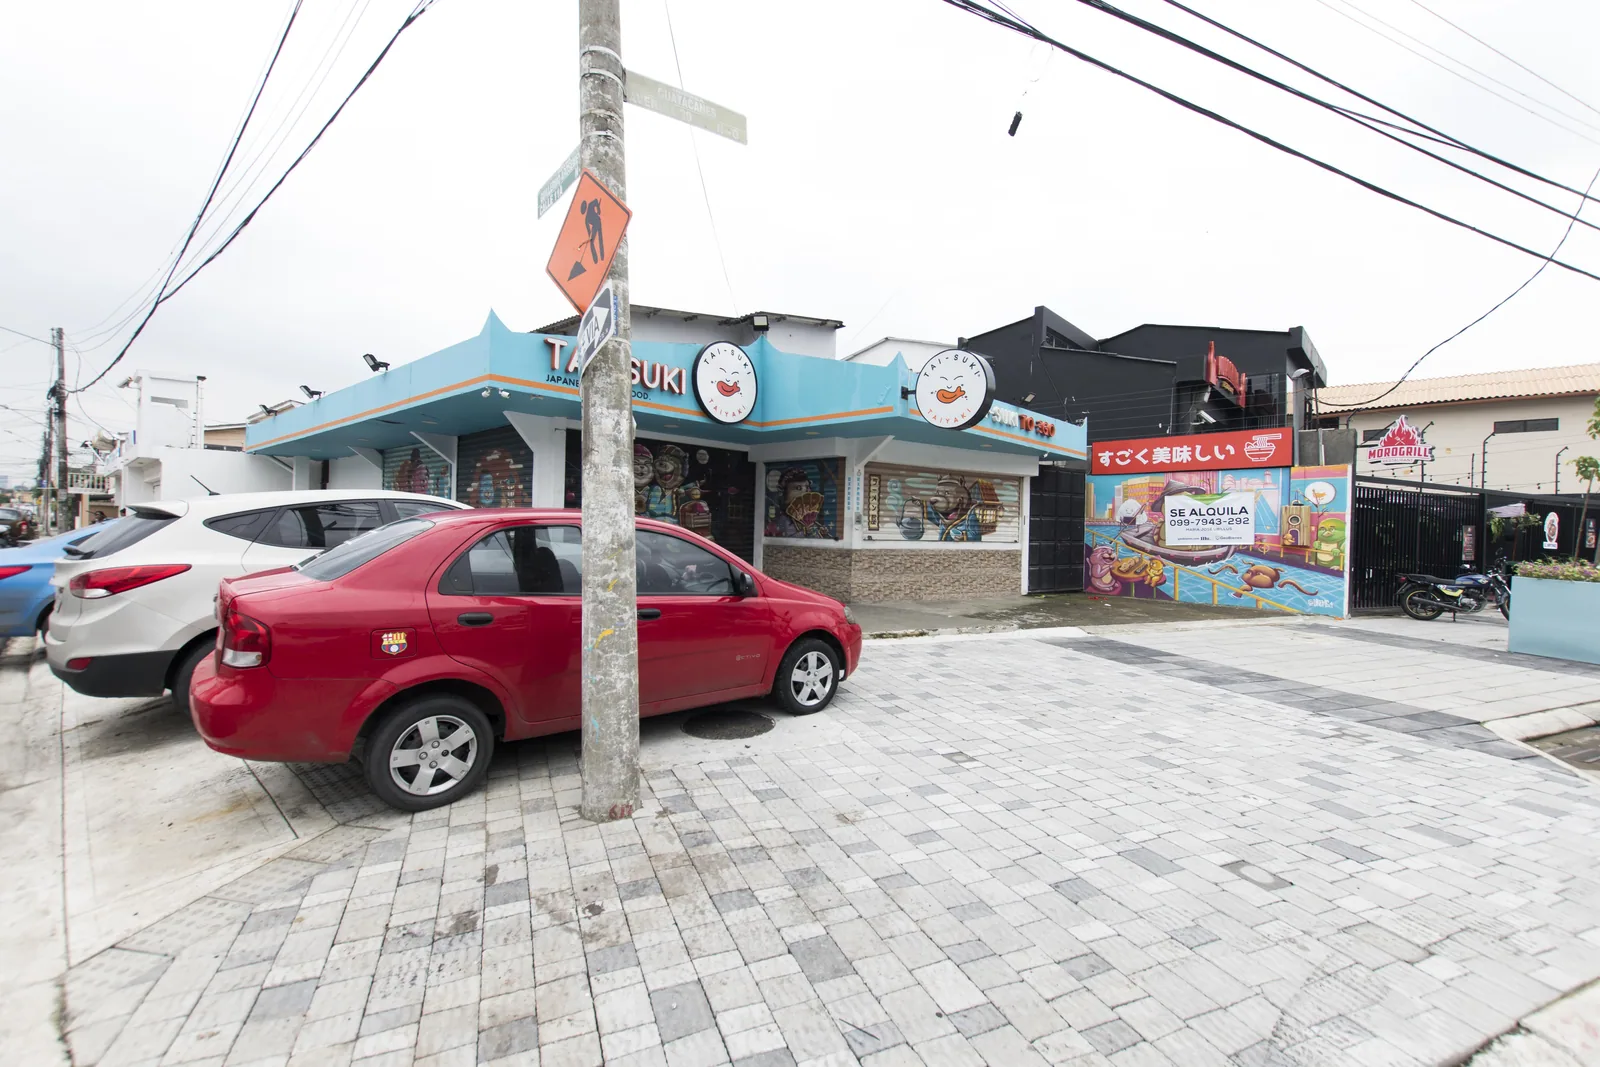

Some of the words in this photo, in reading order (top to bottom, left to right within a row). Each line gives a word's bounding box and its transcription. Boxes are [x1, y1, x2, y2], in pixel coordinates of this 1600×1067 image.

[704, 348, 752, 375] TAI-SUKI
[924, 354, 980, 377] TAI-SUKI
[546, 373, 579, 388] JAPANE
[632, 390, 652, 401] OOD.
[709, 399, 746, 417] TAIYAKI
[928, 408, 971, 423] TAIYAKI
[1098, 444, 1235, 467] すごく美味しい
[1368, 446, 1429, 459] MOROGRILL
[1170, 508, 1186, 518] SE
[1189, 506, 1249, 517] ALQUILA
[1169, 517, 1250, 527] 099-7943-292
